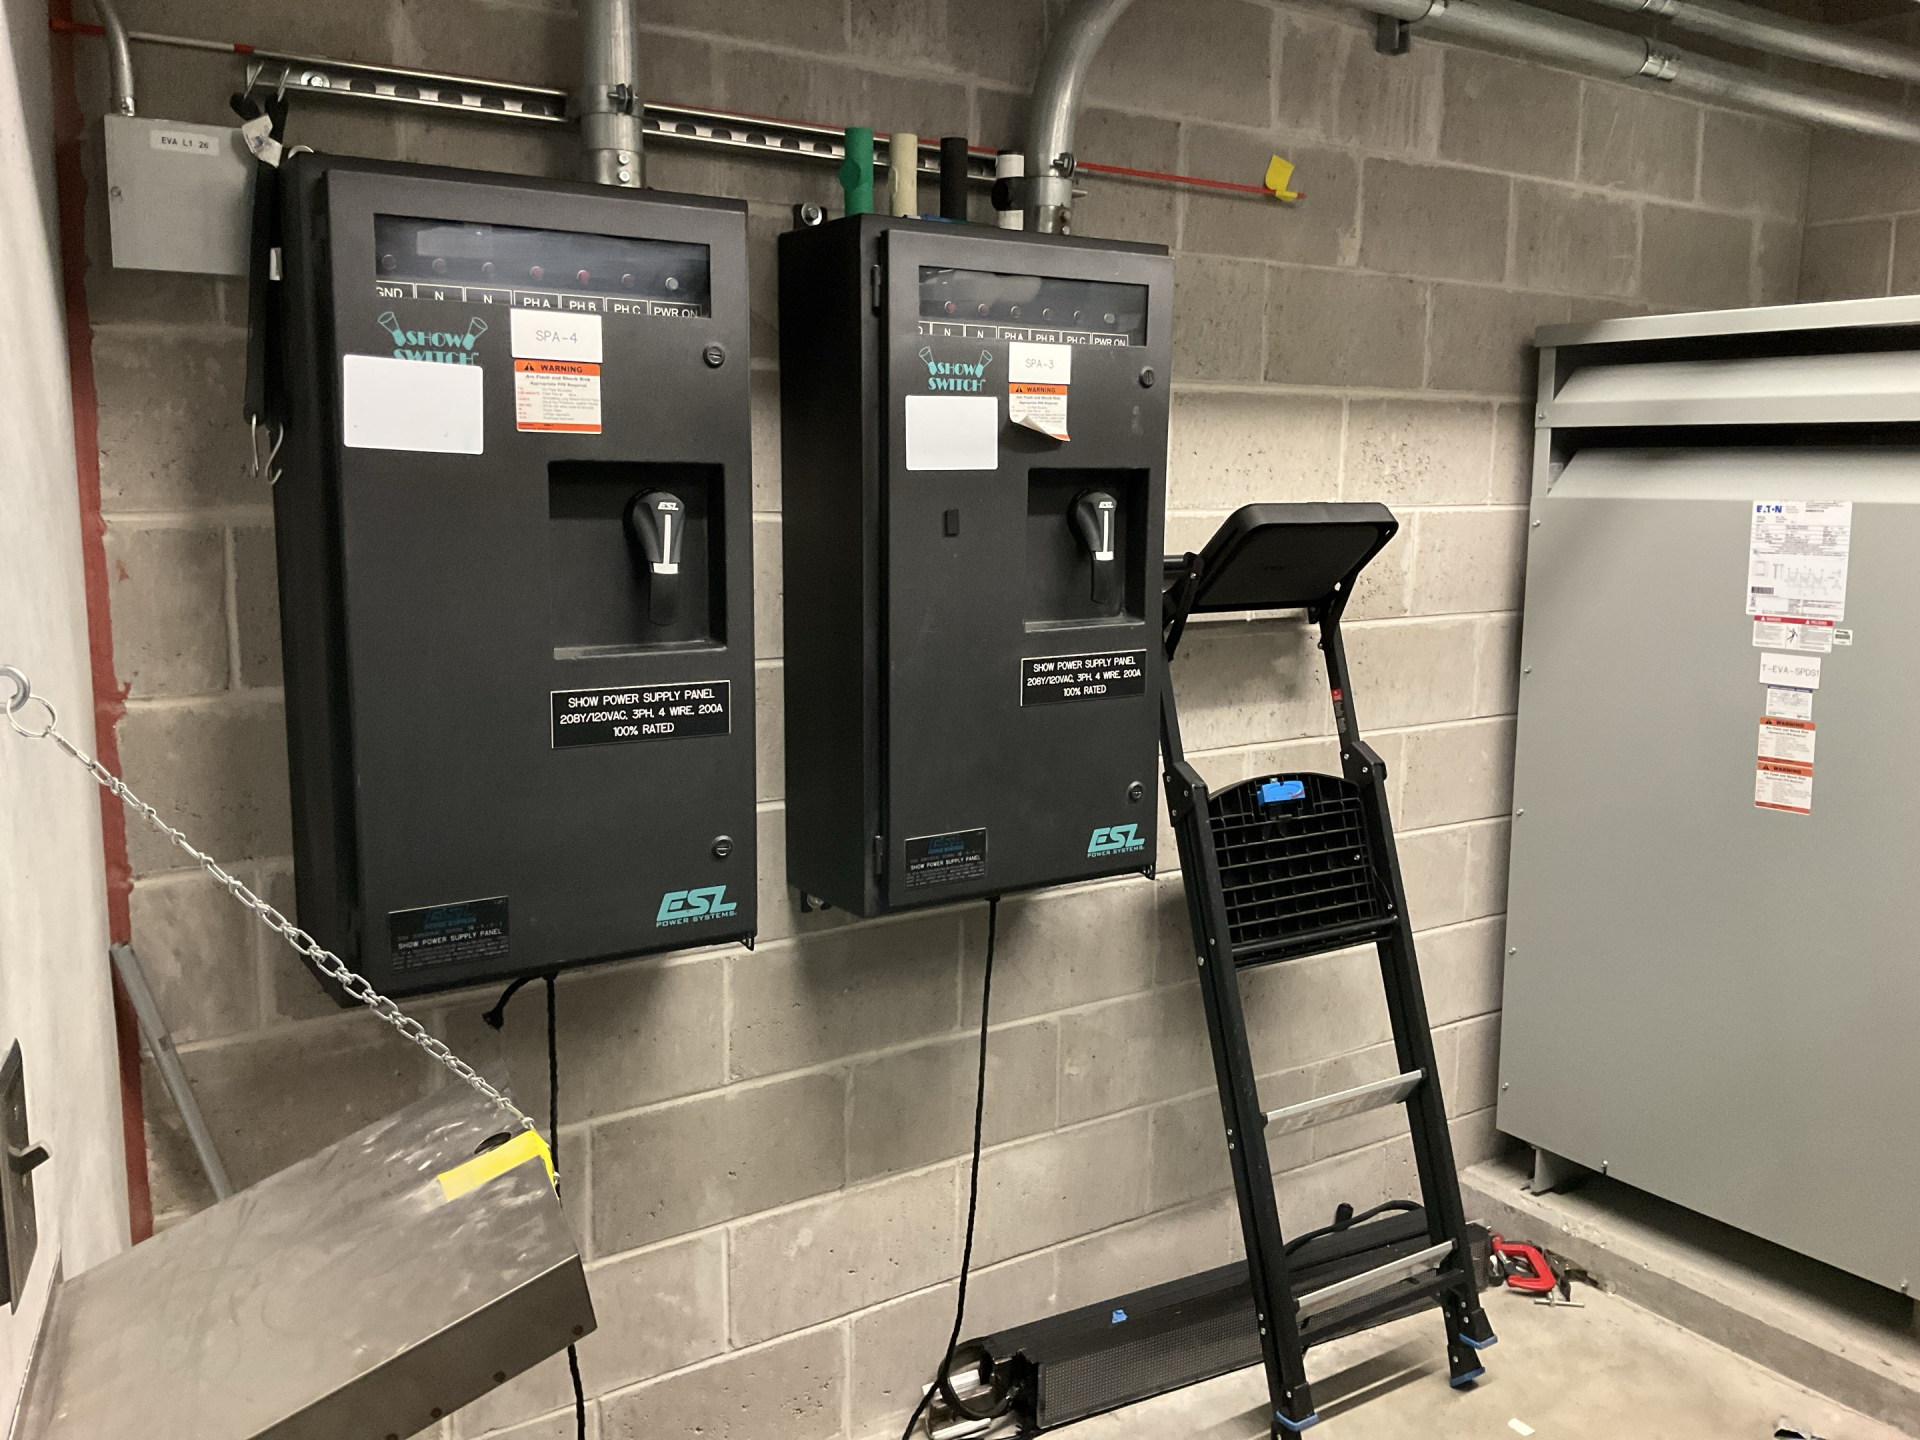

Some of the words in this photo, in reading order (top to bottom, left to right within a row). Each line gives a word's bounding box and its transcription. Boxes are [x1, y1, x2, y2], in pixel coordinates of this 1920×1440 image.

[161, 136, 178, 145] EVA
[182, 139, 193, 147] L1
[198, 141, 209, 149] 26
[434, 290, 444, 301] N
[483, 294, 493, 304] N
[523, 297, 541, 307] PH
[542, 298, 551, 308] A
[569, 300, 586, 311] PH
[614, 303, 630, 313] PH
[632, 304, 641, 315] C
[653, 306, 679, 317] PWR
[681, 308, 698, 318] ON
[535, 329, 578, 344] SPA-4
[944, 327, 951, 336] N
[977, 330, 984, 339] N
[1004, 332, 1017, 340] PH
[1017, 332, 1024, 341] A
[405, 330, 464, 348] SHOW
[1035, 334, 1048, 342] PH
[1066, 335, 1078, 344] PH
[1094, 337, 1112, 346] PWR
[1114, 338, 1126, 346] ON
[393, 348, 474, 366] SWITCH
[540, 364, 583, 373] WARNING
[937, 361, 977, 376] SHOW
[1025, 358, 1055, 369] SPA-3
[928, 376, 982, 392] SWITCH
[1033, 662, 1055, 673] SHOW
[1056, 660, 1083, 671] POWER
[1084, 658, 1112, 669] SUPPLY
[1113, 656, 1136, 666] PANEL
[1094, 672, 1101, 680] 4
[1123, 668, 1142, 678] 200A
[1063, 687, 1081, 697] 100%
[1083, 684, 1107, 695] RATED
[567, 695, 599, 709] SHOW
[602, 692, 640, 706] POWER
[642, 690, 681, 704] SUPPLY
[684, 687, 716, 700] PANEL
[657, 706, 667, 718] 4
[698, 702, 724, 715] 200A
[612, 725, 639, 738] 100%
[642, 722, 675, 736] RATED
[1776, 720, 1805, 728] WARNING
[1773, 766, 1802, 774] WARNING
[1087, 823, 1146, 853] ESL
[1087, 850, 1111, 858] POWER
[1112, 845, 1144, 855] SYSTEMS
[910, 863, 925, 871] SHOW
[926, 860, 944, 868] POWER
[945, 857, 964, 865] SUPPLY
[965, 854, 981, 862] PANEL
[656, 884, 738, 922] ESL
[656, 917, 689, 928] POWER
[692, 910, 736, 923] SYSTEMS
[397, 941, 419, 950] SHOW
[422, 936, 448, 946] POWER
[450, 931, 477, 942] SUPPLY
[480, 928, 503, 937] PANEL
